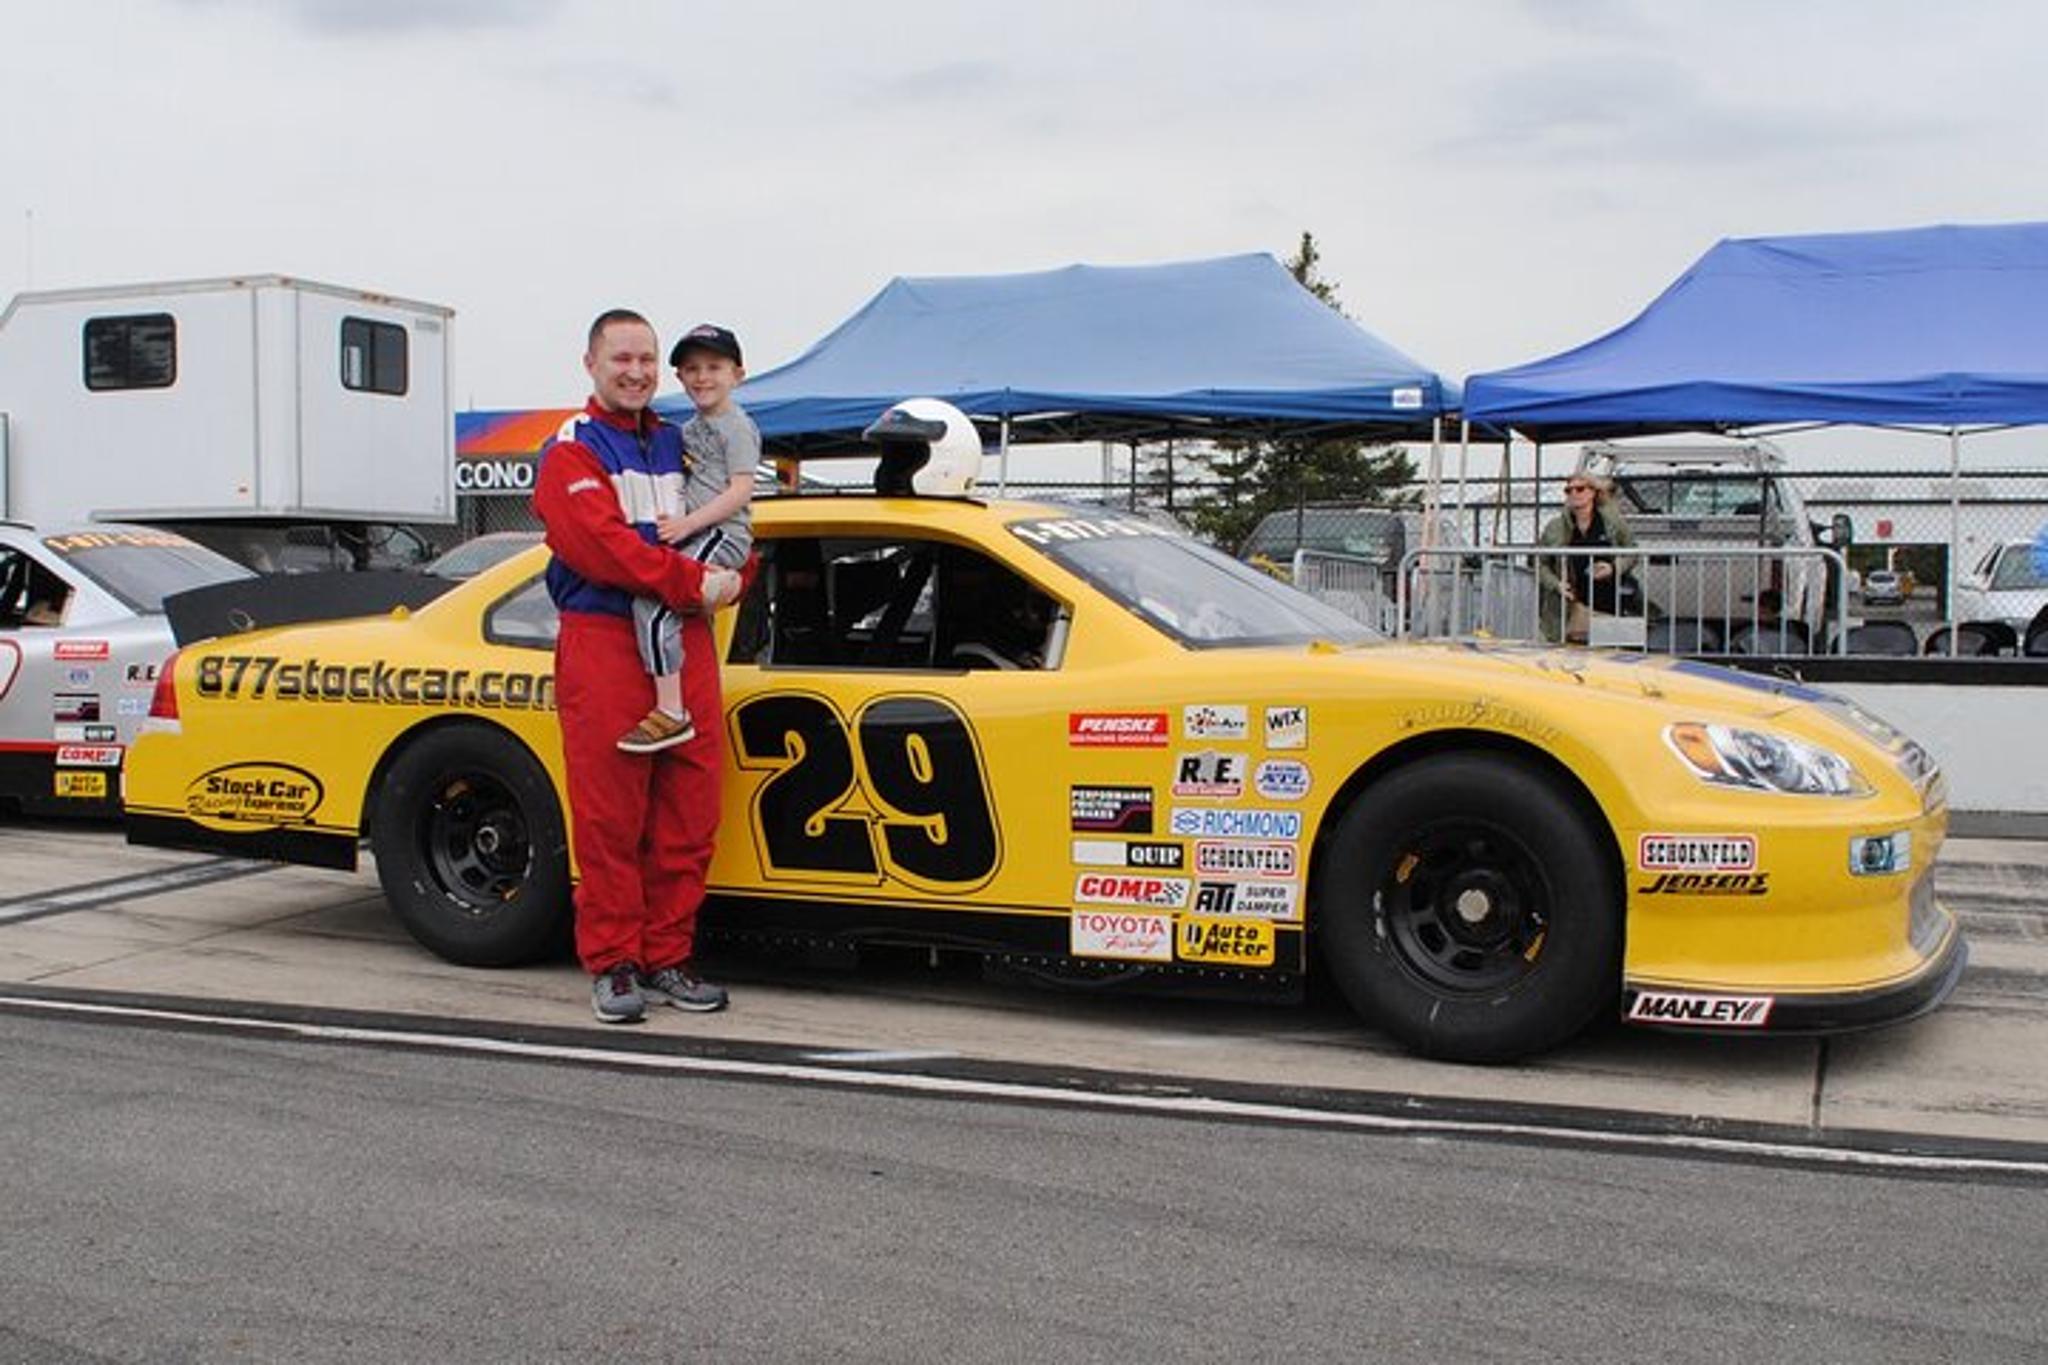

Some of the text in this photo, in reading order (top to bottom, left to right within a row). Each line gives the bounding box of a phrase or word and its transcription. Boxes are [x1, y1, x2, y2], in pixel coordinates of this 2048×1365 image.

[1078, 717, 1160, 732] PENSKE
[1268, 709, 1301, 730] WIX
[206, 776, 310, 801] Stock Car
[727, 688, 1004, 895] 29
[1203, 812, 1298, 837] RICHMOND
[1130, 846, 1182, 865] QUIP
[1201, 847, 1290, 870] SCHOENFELD
[1646, 843, 1750, 864] SCHOENFELD
[1081, 877, 1163, 898] COMP
[1195, 882, 1237, 913] ATI
[1246, 886, 1287, 899] SUPER
[1237, 901, 1290, 914] DAMPER
[1079, 914, 1166, 935] TOYOTA
[1206, 922, 1260, 942] Auto
[1201, 937, 1269, 956] Meter
[1638, 996, 1751, 1022] MANLEY
